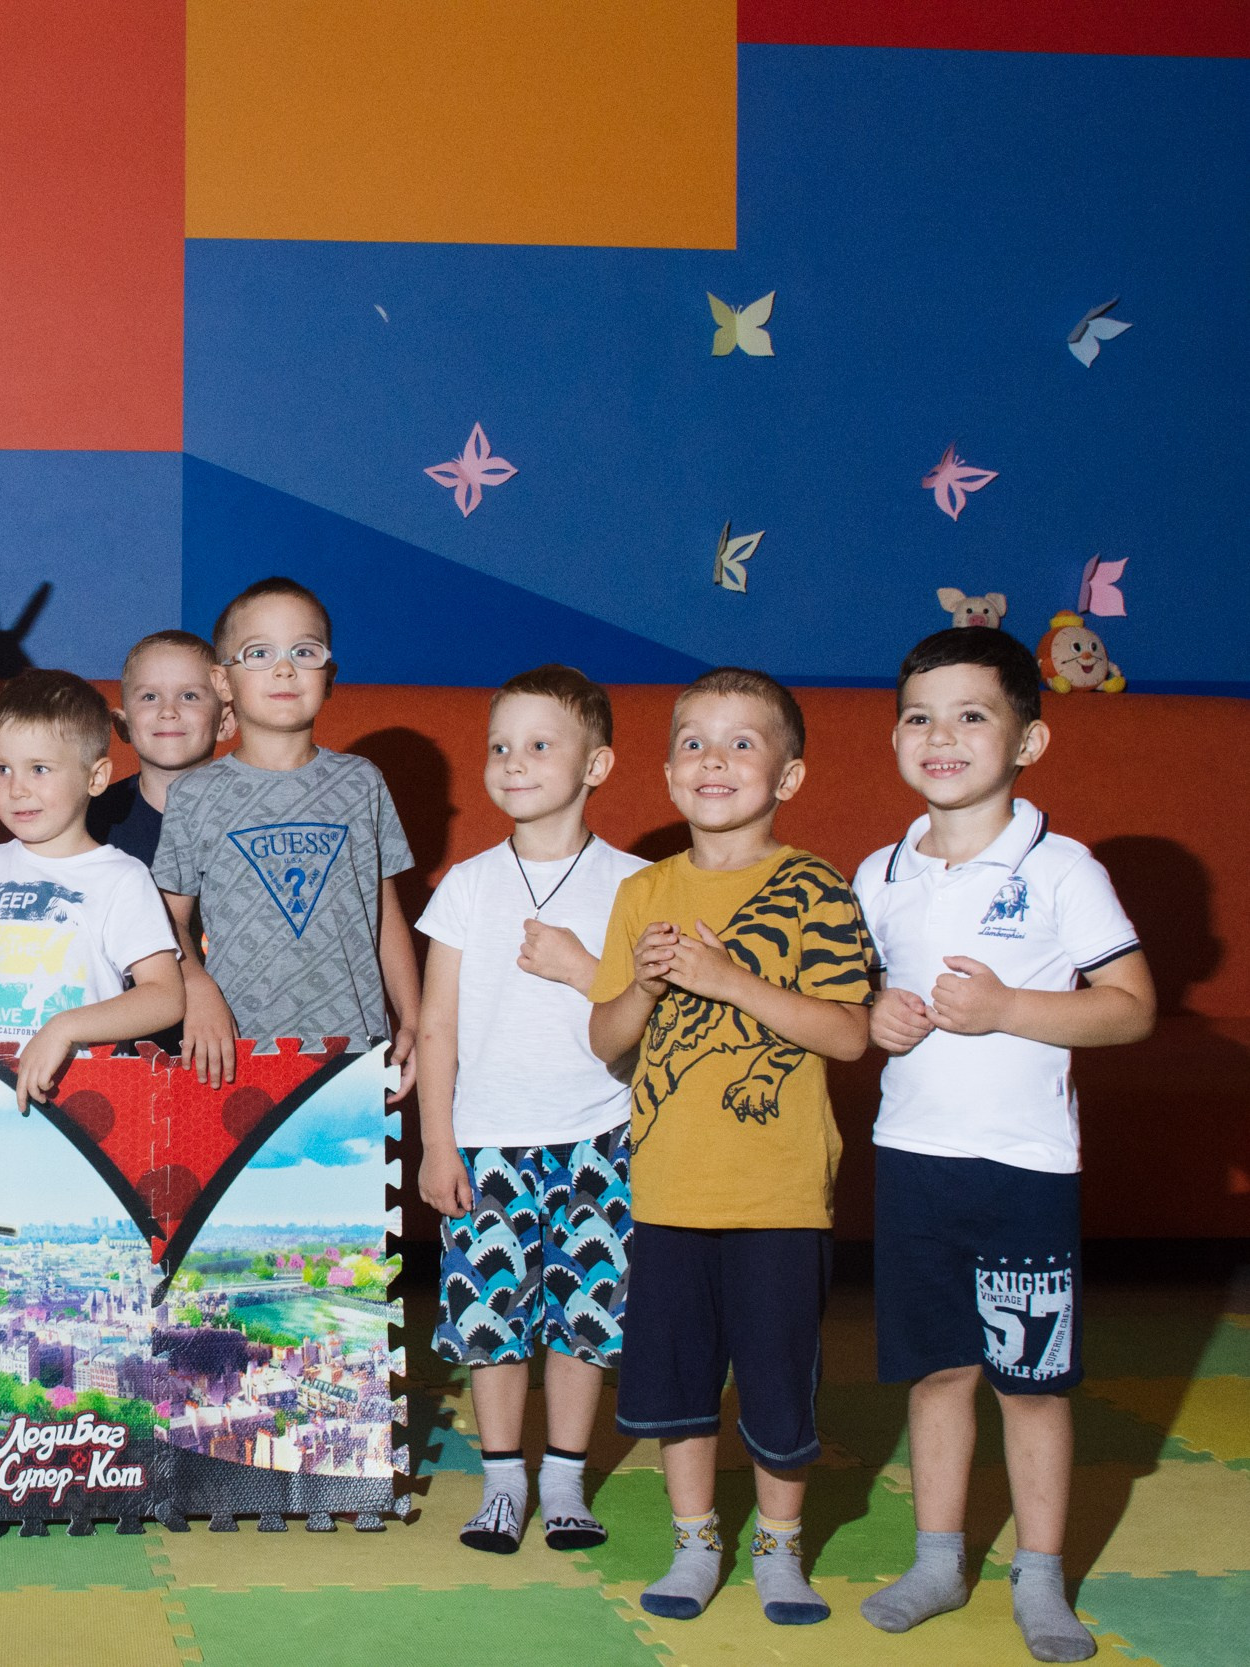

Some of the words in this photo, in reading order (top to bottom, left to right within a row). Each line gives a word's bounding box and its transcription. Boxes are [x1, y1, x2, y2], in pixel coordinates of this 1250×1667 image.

[976, 1268, 1072, 1296] KNIGHTS
[980, 1291, 1022, 1306] VINTAGE
[977, 1288, 1073, 1373] 57
[1045, 1330, 1066, 1367] SUPERIOR
[1059, 1303, 1072, 1329] CREW
